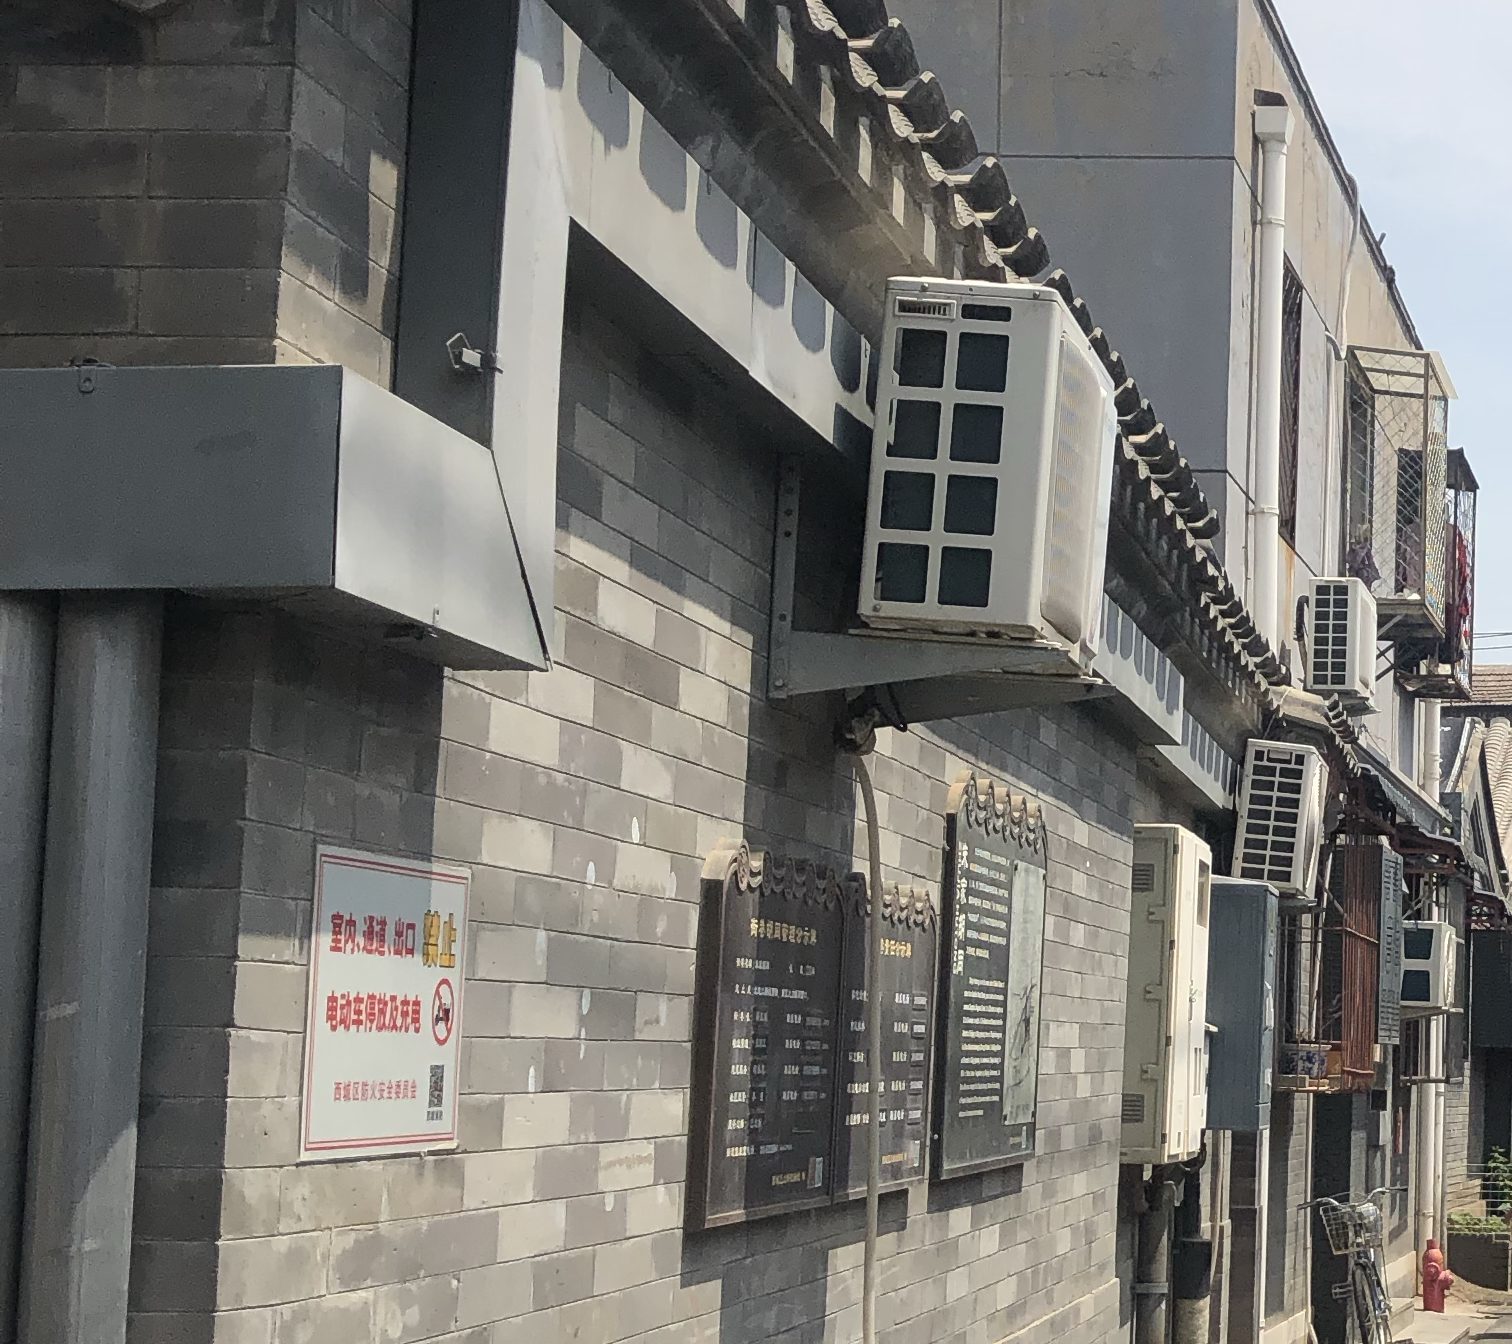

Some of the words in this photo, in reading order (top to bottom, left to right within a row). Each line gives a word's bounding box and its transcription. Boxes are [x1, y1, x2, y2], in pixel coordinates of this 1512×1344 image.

[329, 911, 416, 959] 室内、通道、出口
[422, 909, 458, 968] 禁止
[325, 991, 422, 1034] 电动车停放及充电
[333, 1079, 418, 1102] 西城区防火安全委员会
